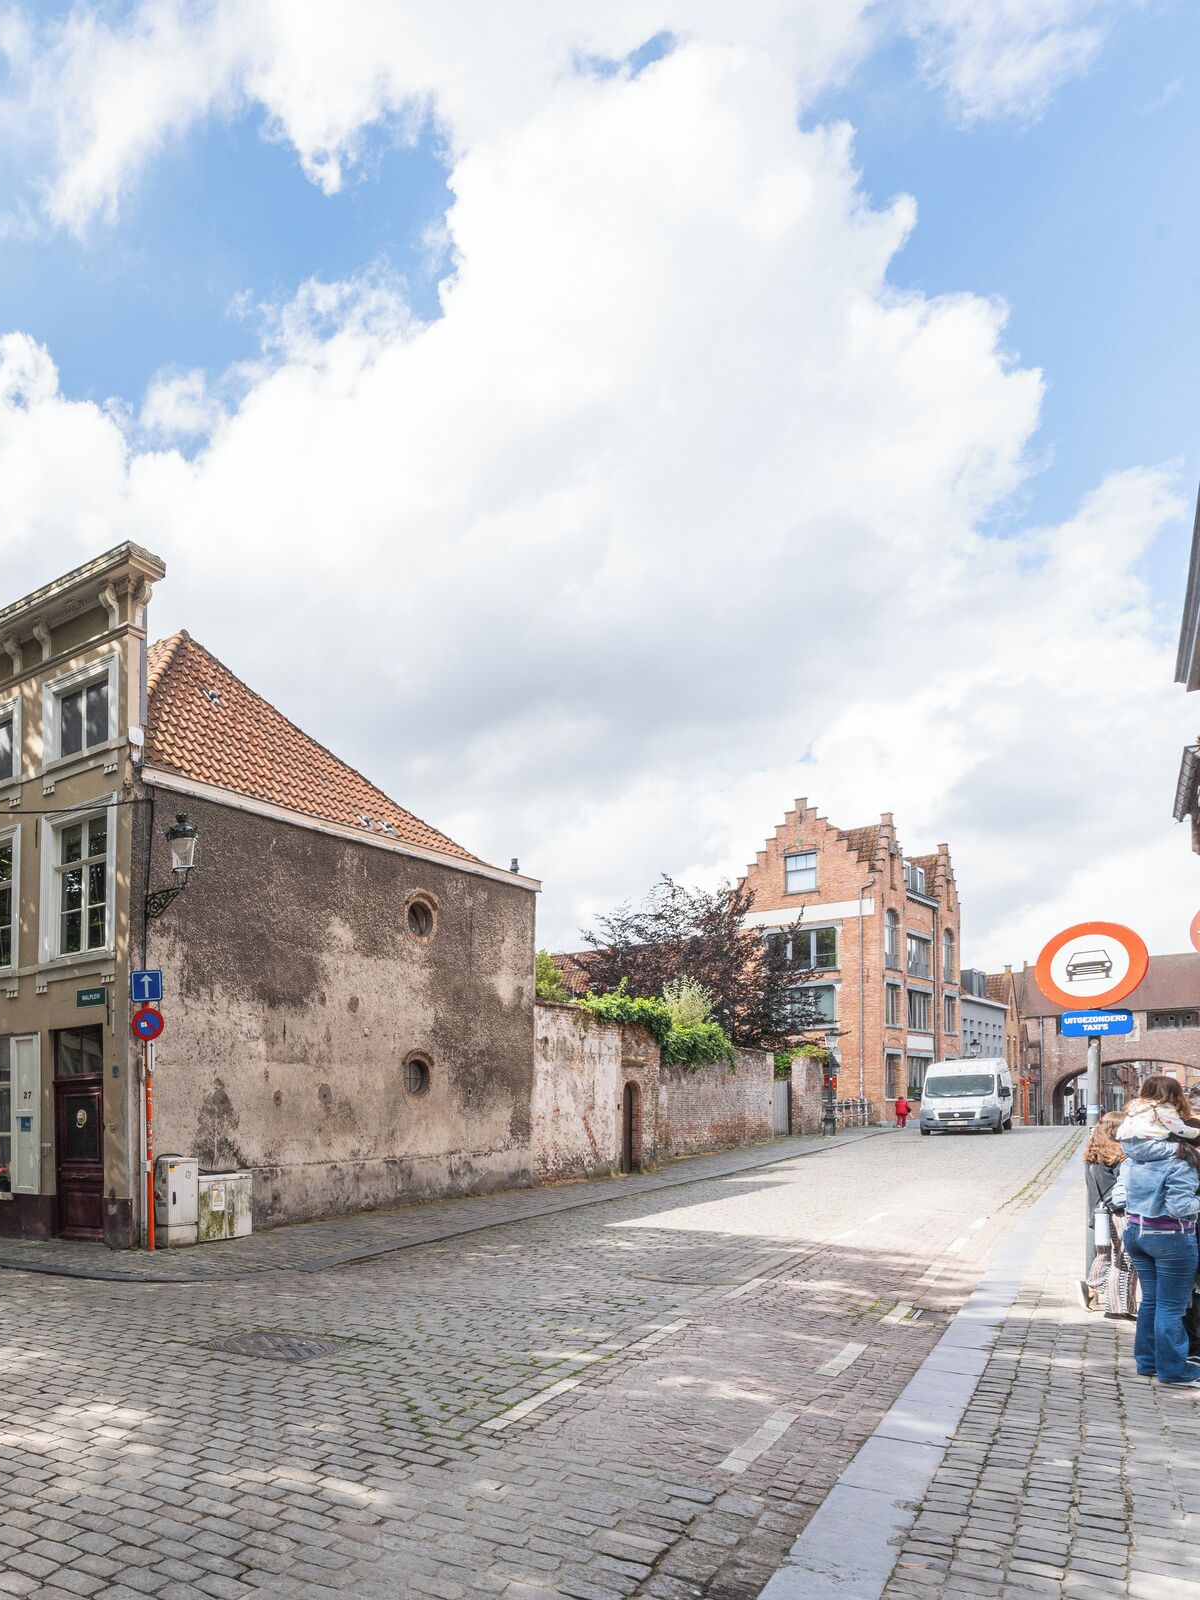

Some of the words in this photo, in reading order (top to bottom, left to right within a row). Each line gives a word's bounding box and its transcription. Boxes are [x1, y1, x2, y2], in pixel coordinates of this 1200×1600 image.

[81, 993, 101, 1001] WALPLEIN
[1064, 1015, 1128, 1025] UITGEZONDERD
[1082, 1023, 1109, 1031] TAXI'S
[23, 1091, 32, 1099] 27
